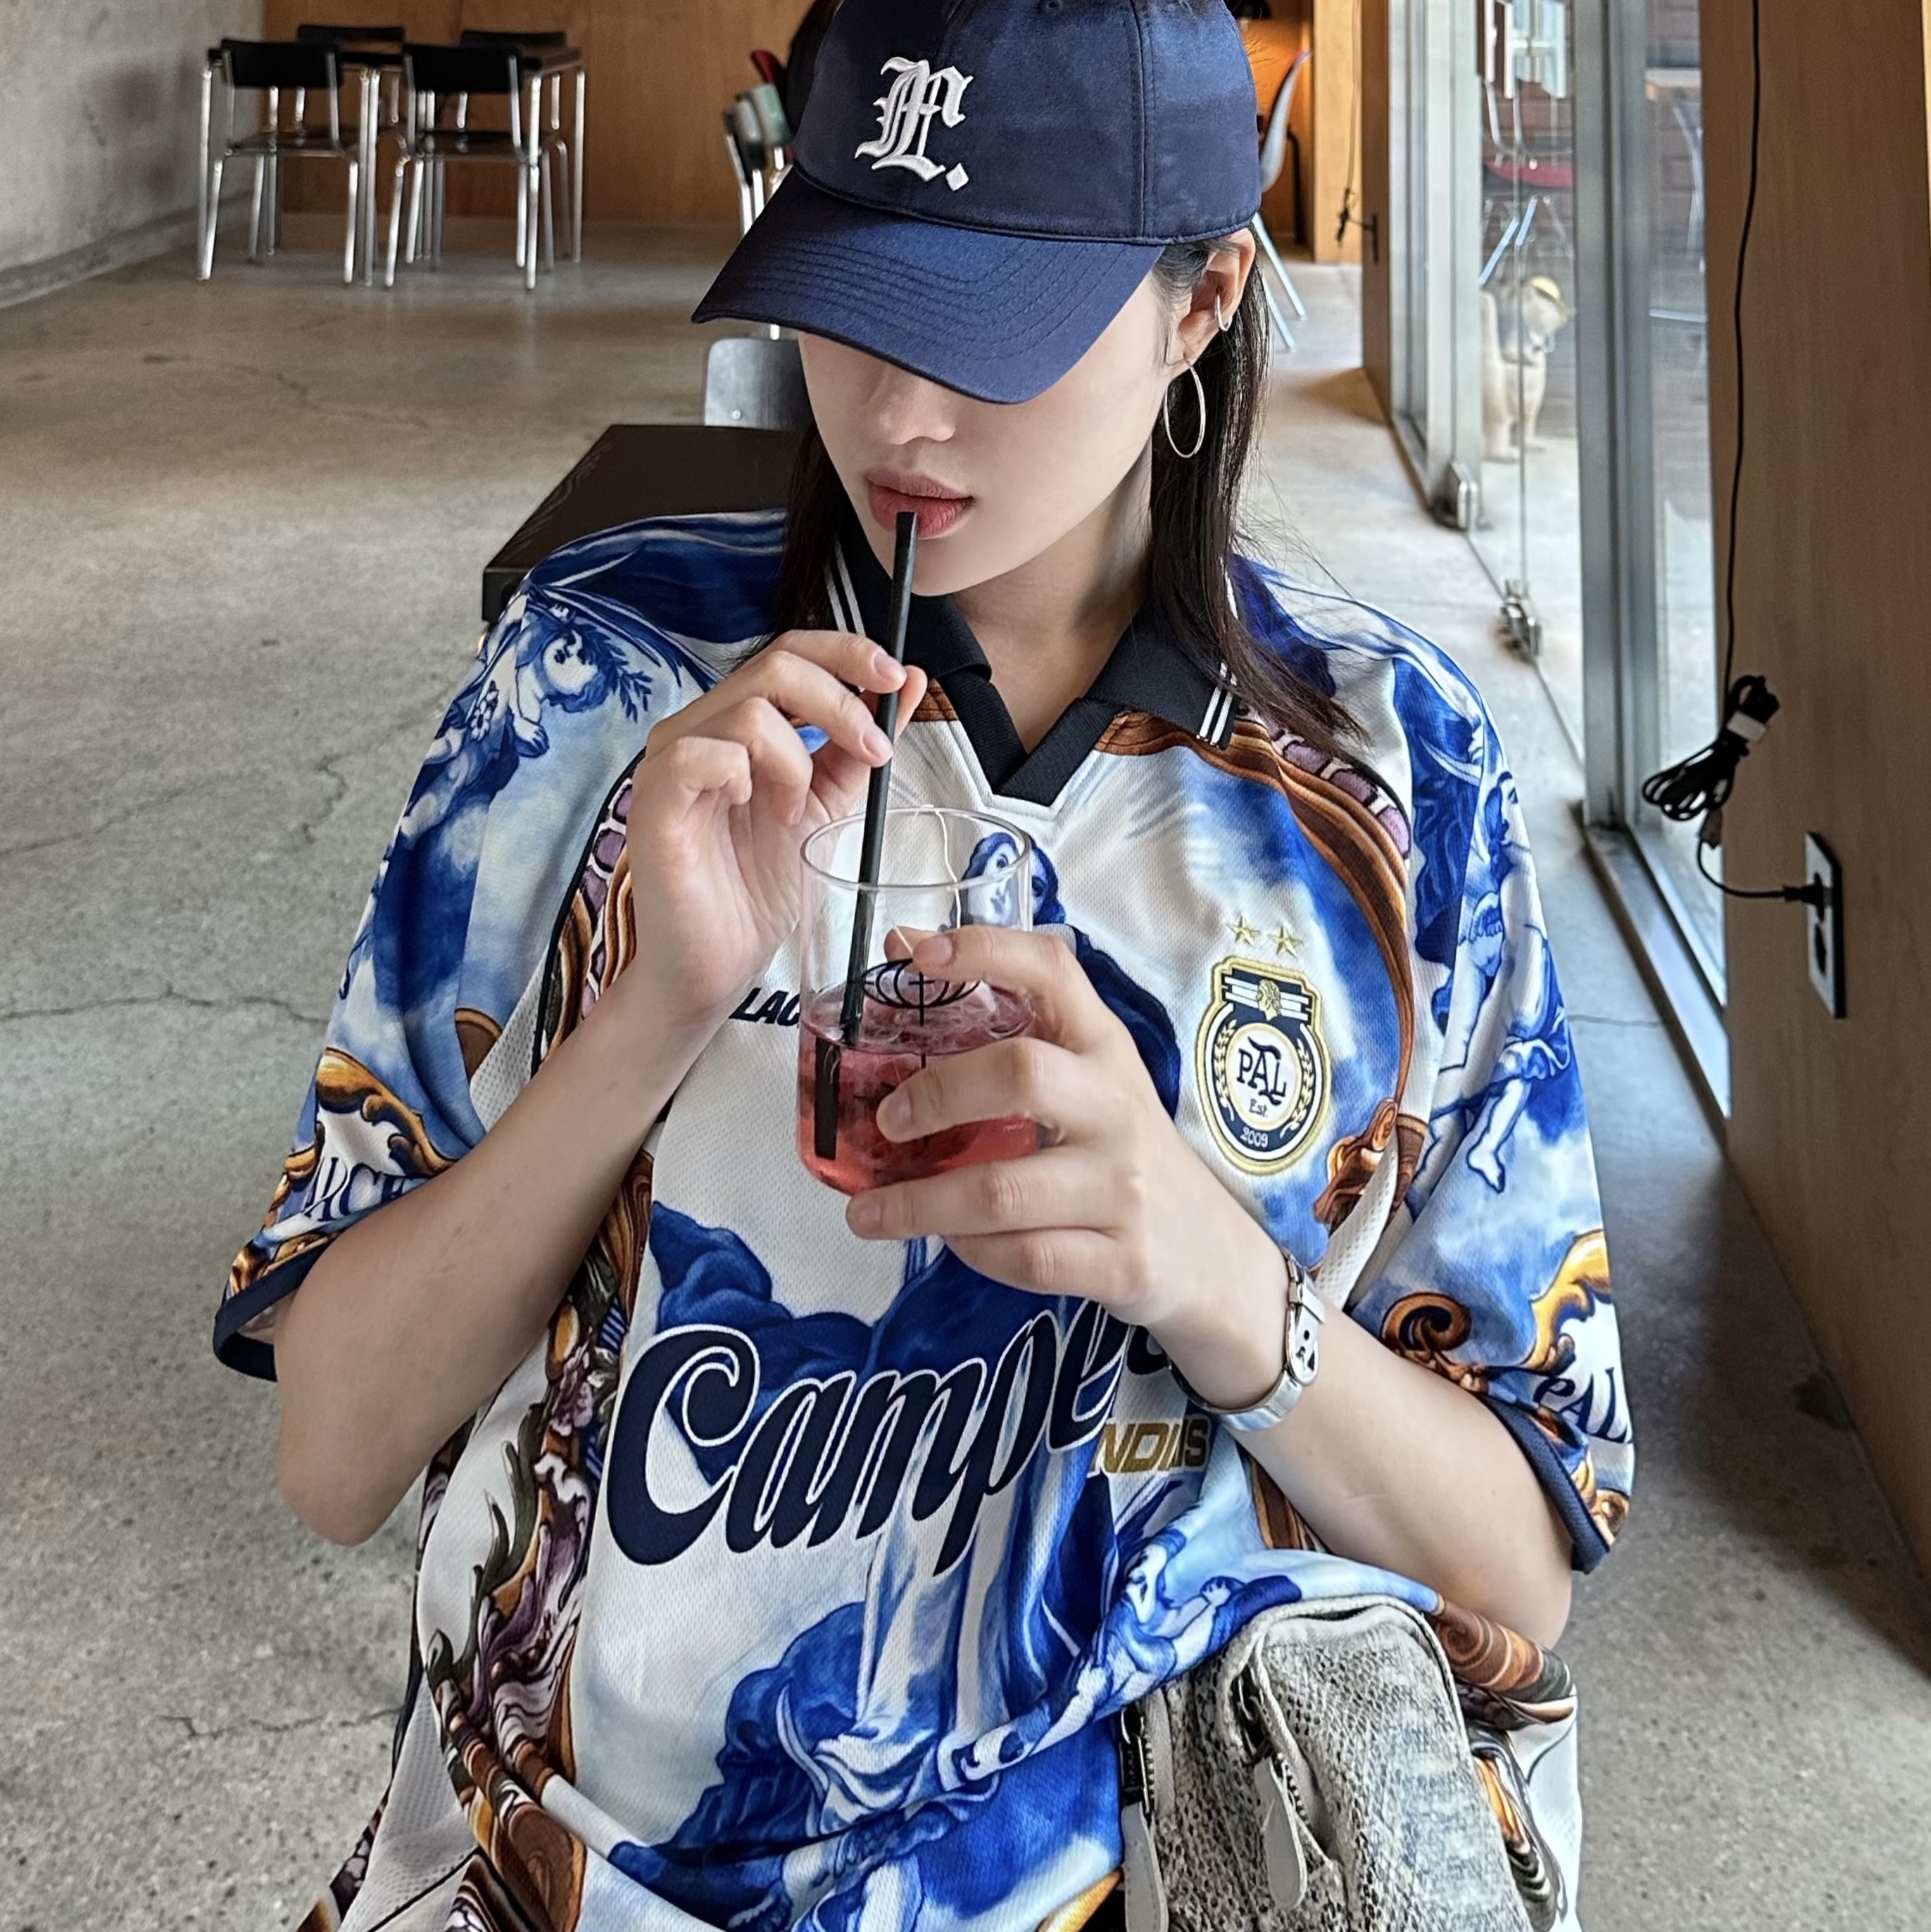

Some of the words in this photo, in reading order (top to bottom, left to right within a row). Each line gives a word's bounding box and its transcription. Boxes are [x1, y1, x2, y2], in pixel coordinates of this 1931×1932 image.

[729, 987, 801, 1027] LAC
[1236, 1035, 1288, 1107] PAL
[1239, 1125, 1269, 1149] 2009
